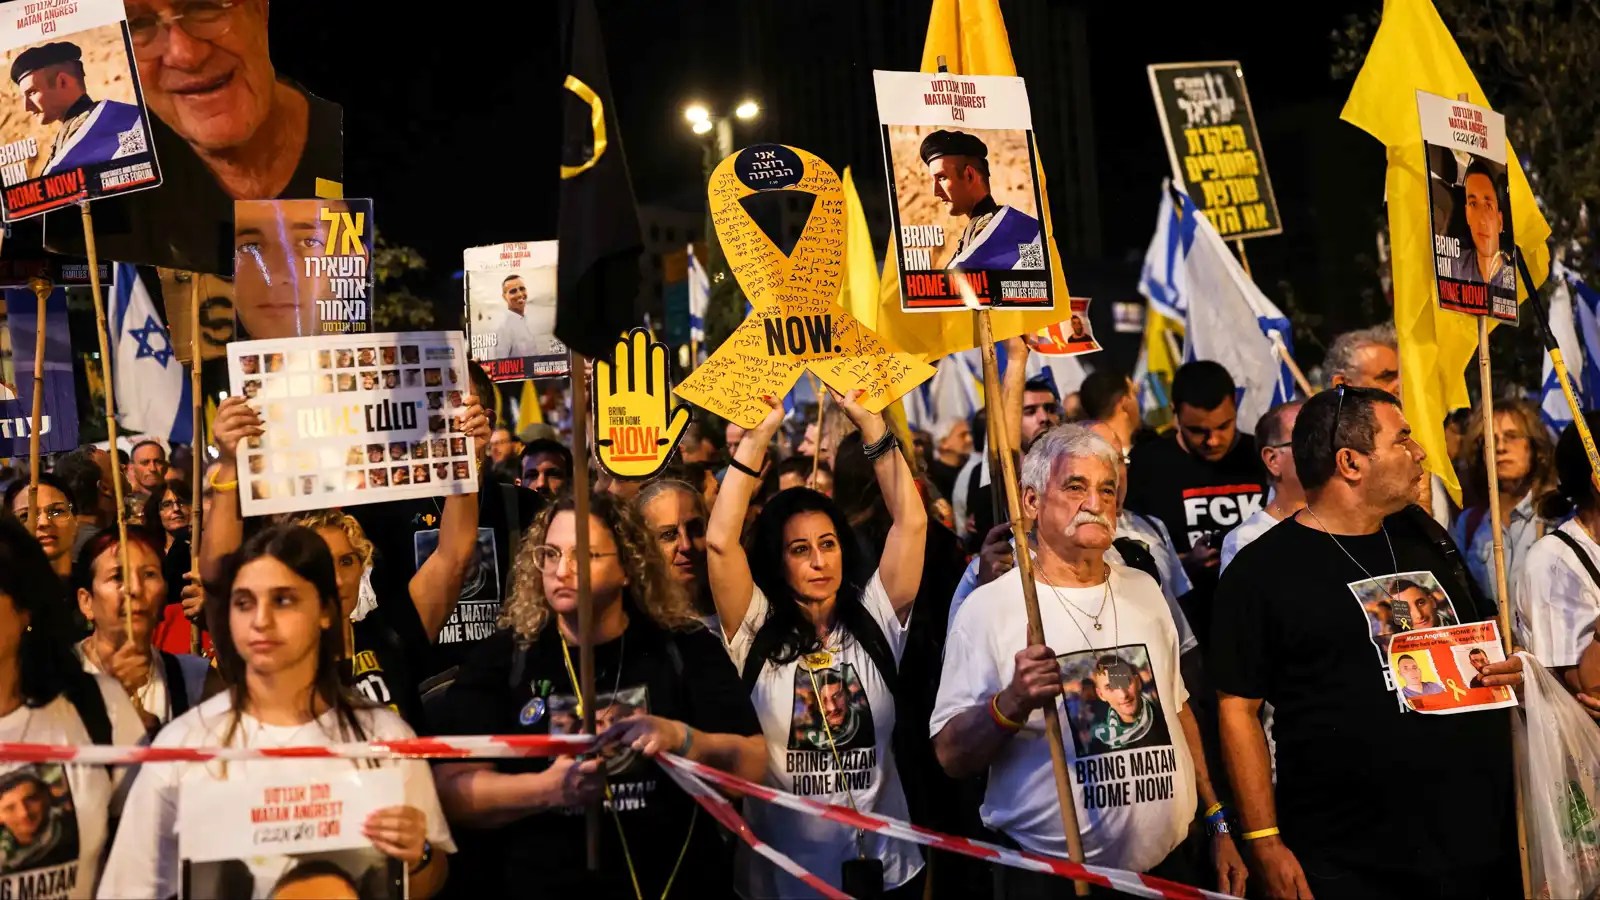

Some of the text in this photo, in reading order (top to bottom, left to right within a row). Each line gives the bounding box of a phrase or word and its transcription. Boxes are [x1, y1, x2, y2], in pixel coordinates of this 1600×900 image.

[17, 2, 78, 29] MATAN ANGREST
[41, 20, 56, 35] (21)
[931, 80, 976, 95] מתן אנגרסט
[924, 93, 986, 108] MATAN ANGREST
[952, 106, 965, 122] (21)
[1448, 117, 1488, 137] MATAN ANGREST
[0, 137, 37, 166] BRING
[754, 150, 776, 160] אני
[0, 162, 28, 187] HIM
[748, 167, 794, 180] הביתה
[752, 159, 784, 170] רוצה
[101, 168, 154, 188] FAMILIES FORUM
[6, 167, 86, 210] HOME NOW!
[821, 200, 844, 208] איתן
[824, 207, 843, 215] מור
[320, 208, 365, 255] אל
[901, 225, 944, 248] BRING
[1435, 233, 1461, 258] BRING
[304, 256, 365, 277] תשאירו
[903, 250, 931, 270] HIM
[1436, 256, 1452, 278] HIM
[330, 278, 366, 299] אותי
[906, 274, 947, 297] HOME
[1002, 288, 1048, 299] FAMILIES FORUM
[1440, 280, 1460, 303] HOME
[1461, 284, 1488, 307] NOW!
[316, 300, 365, 320] מאחור
[322, 322, 366, 332] מתן אנגרסט
[764, 315, 841, 357] NOW.
[471, 333, 497, 349] BRING
[472, 347, 488, 361] HIM
[498, 357, 524, 374] NOW!
[364, 399, 423, 433] נקום.
[608, 406, 627, 416] BRING
[609, 415, 641, 425] THEM HOME
[609, 426, 660, 455] NOW
[1183, 494, 1264, 526] FCK
[461, 603, 500, 623] MATAN
[1424, 630, 1450, 641] Angrest
[786, 749, 877, 774] BRING MATAN
[1075, 748, 1177, 785] BRING MATAN
[792, 771, 871, 796] HOME NOW!
[1083, 775, 1174, 809] HOME NOW!
[251, 799, 343, 823] MATAN ANGREST
[18, 863, 78, 900] MATAN
